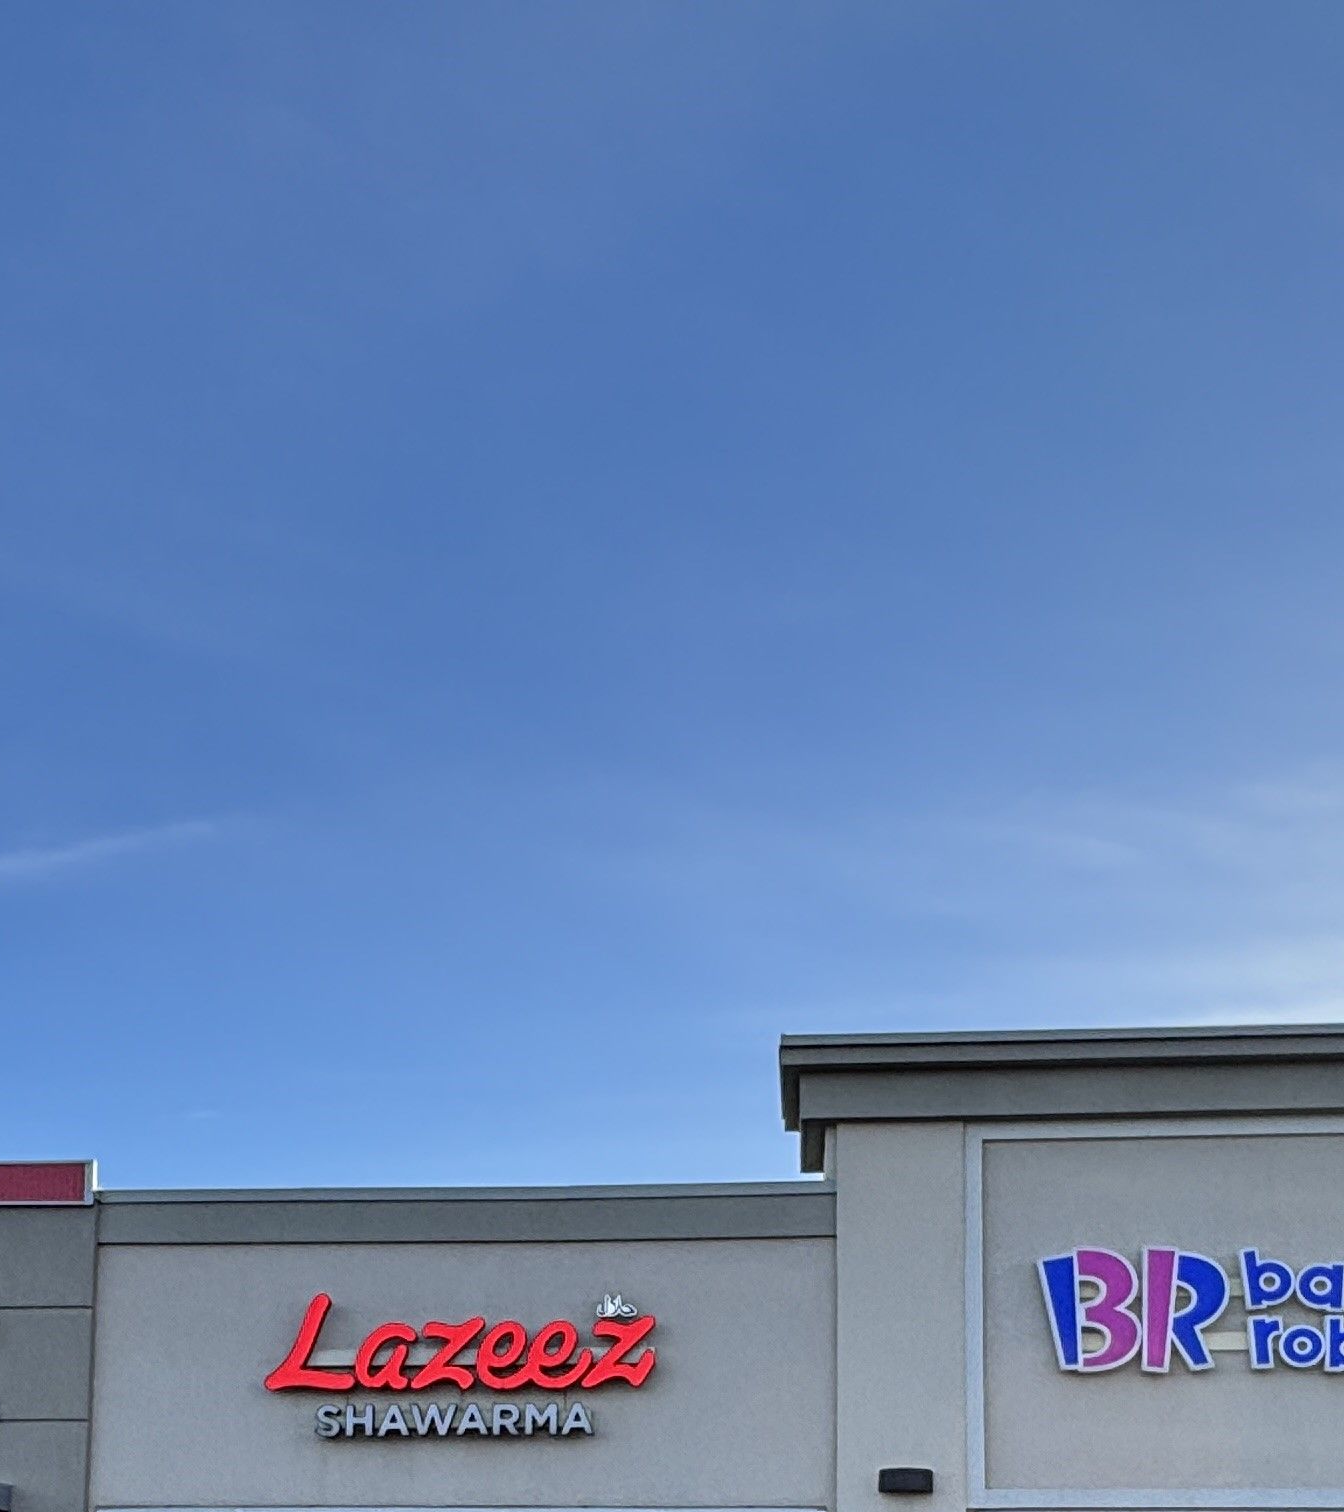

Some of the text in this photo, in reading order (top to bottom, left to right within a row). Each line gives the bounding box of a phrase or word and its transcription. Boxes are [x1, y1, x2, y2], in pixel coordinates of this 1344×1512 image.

[264, 1292, 655, 1390] Lazeez
[1037, 1245, 1230, 1372] BR
[315, 1402, 594, 1438] SHAWARMA
